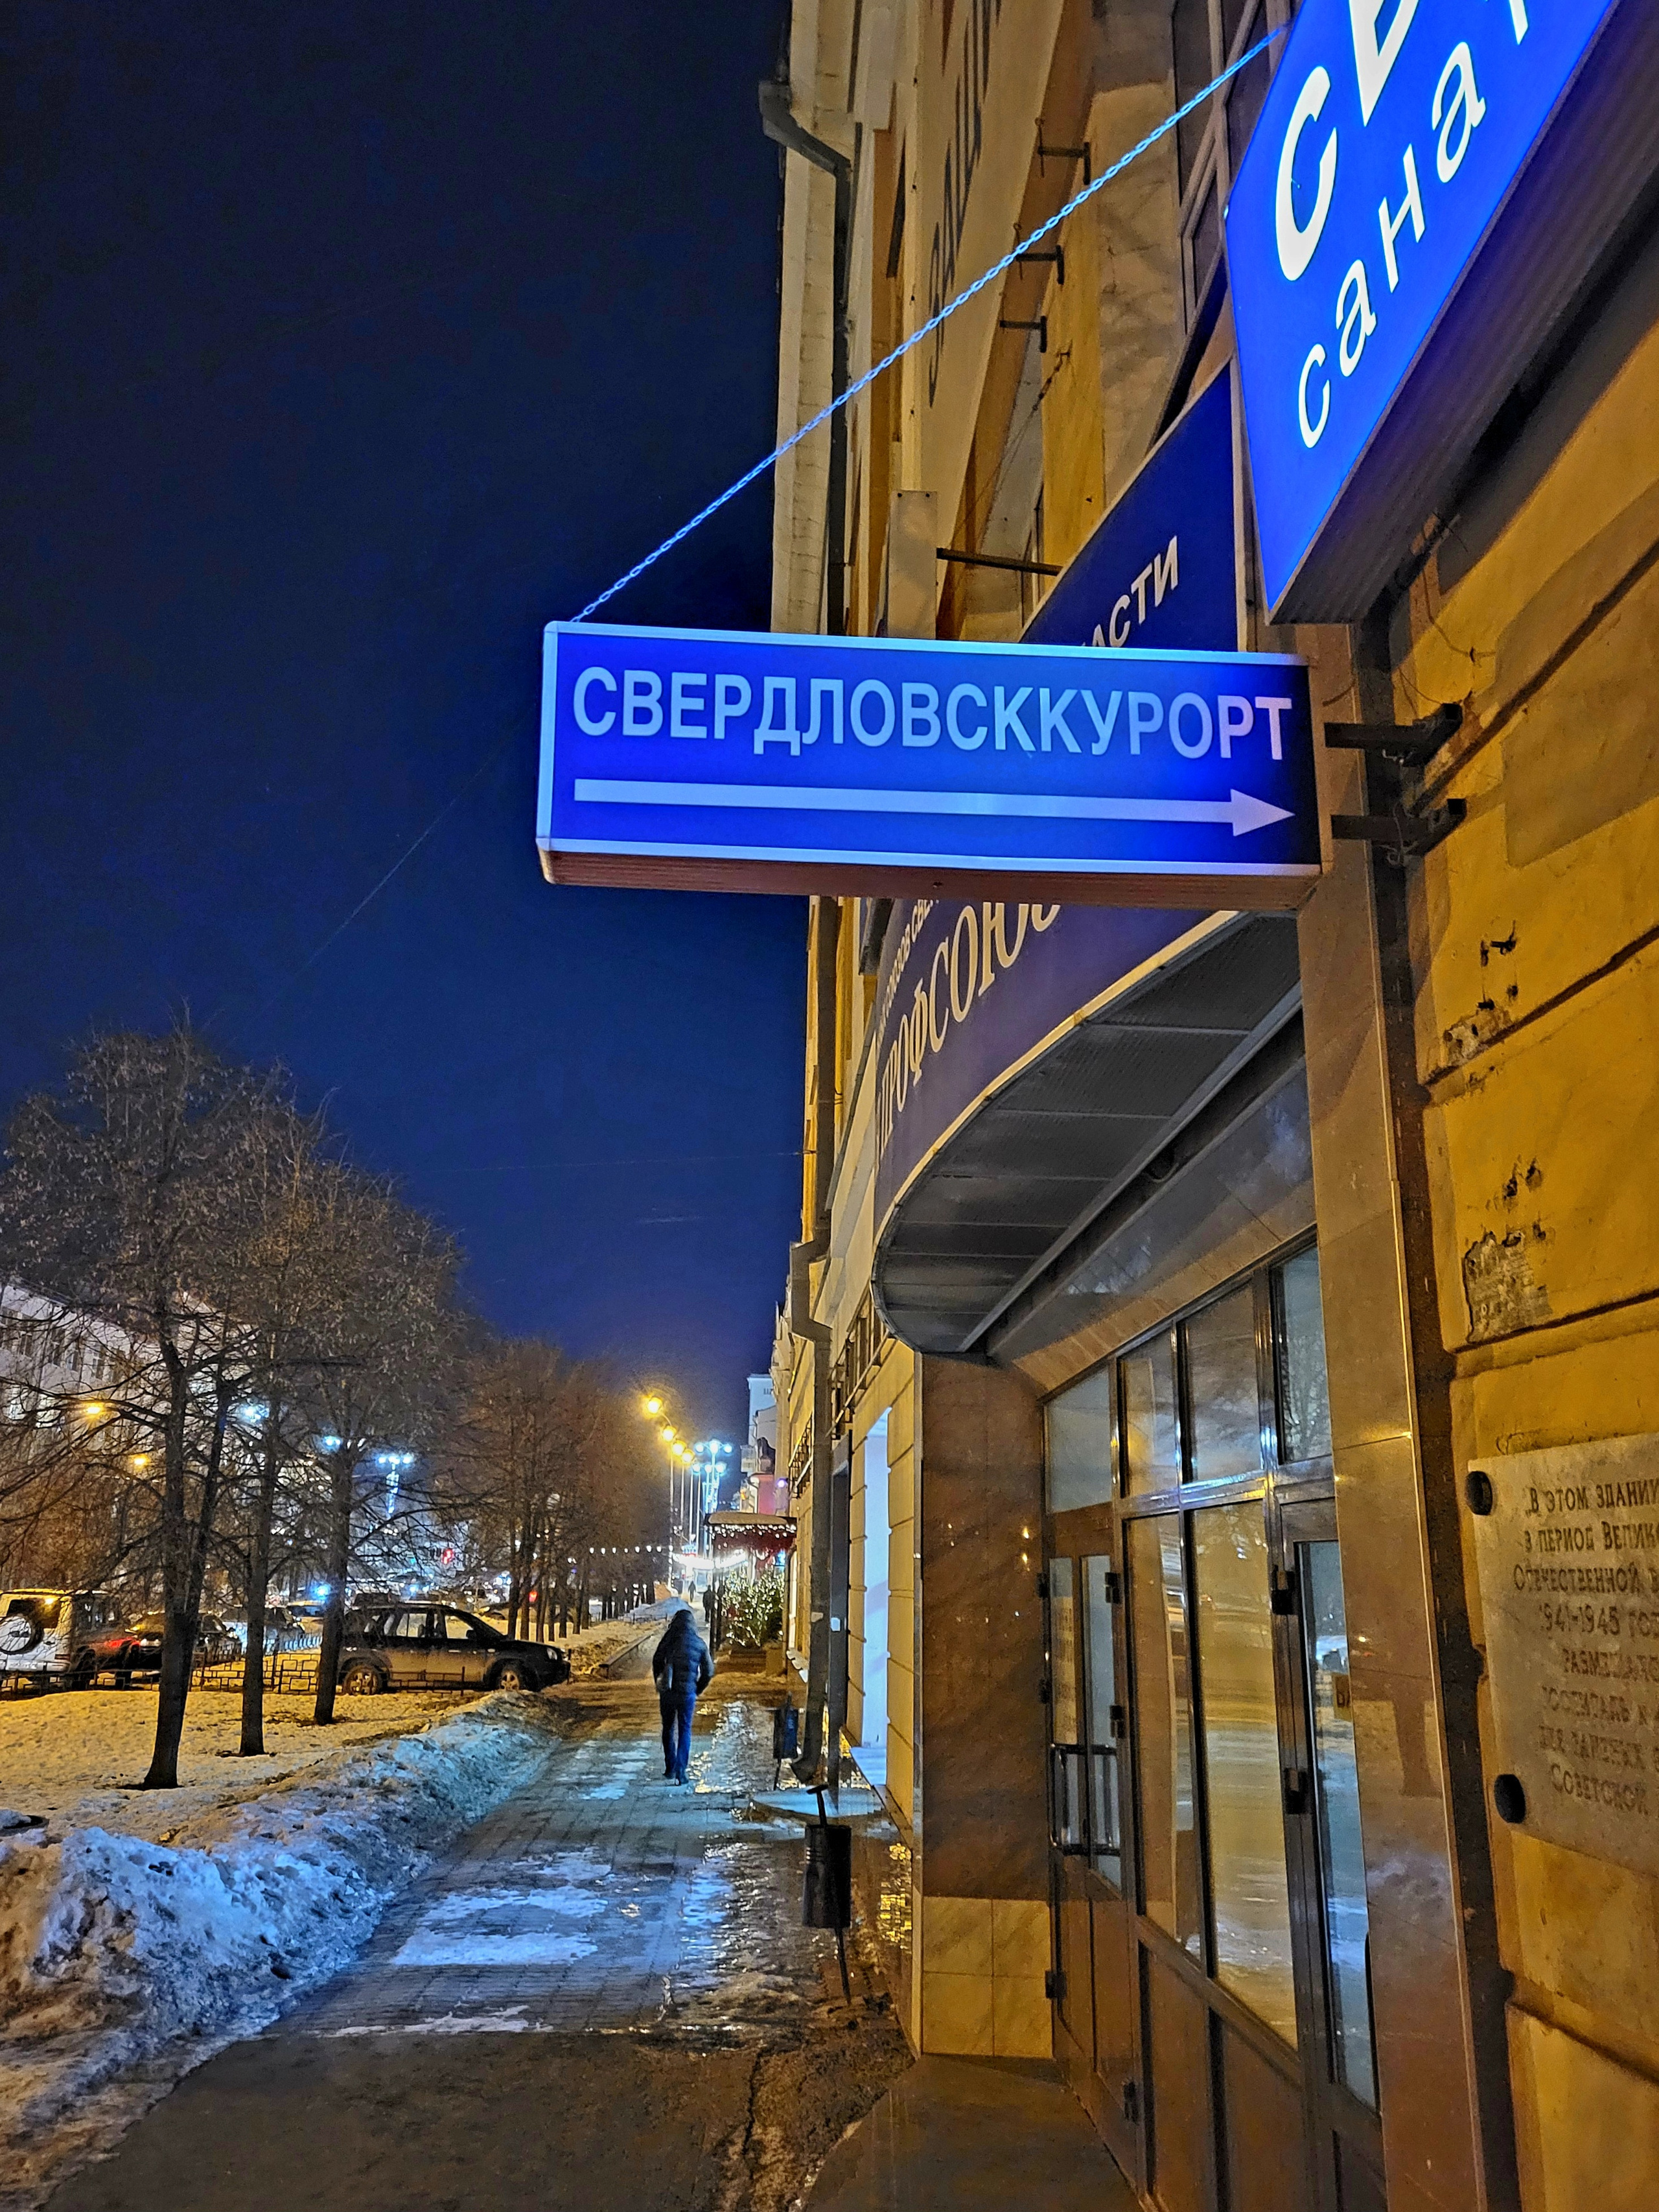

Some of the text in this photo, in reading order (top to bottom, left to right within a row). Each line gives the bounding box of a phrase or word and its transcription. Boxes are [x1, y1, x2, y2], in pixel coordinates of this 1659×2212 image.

[573, 666, 1292, 761] СВЕРДЛОВСККУРОРТ
[881, 901, 1061, 1160] ПРОФСОЮ
[1544, 1486, 1590, 1513] ЭТОМ
[1538, 1526, 1595, 1552] ПЕРИОД
